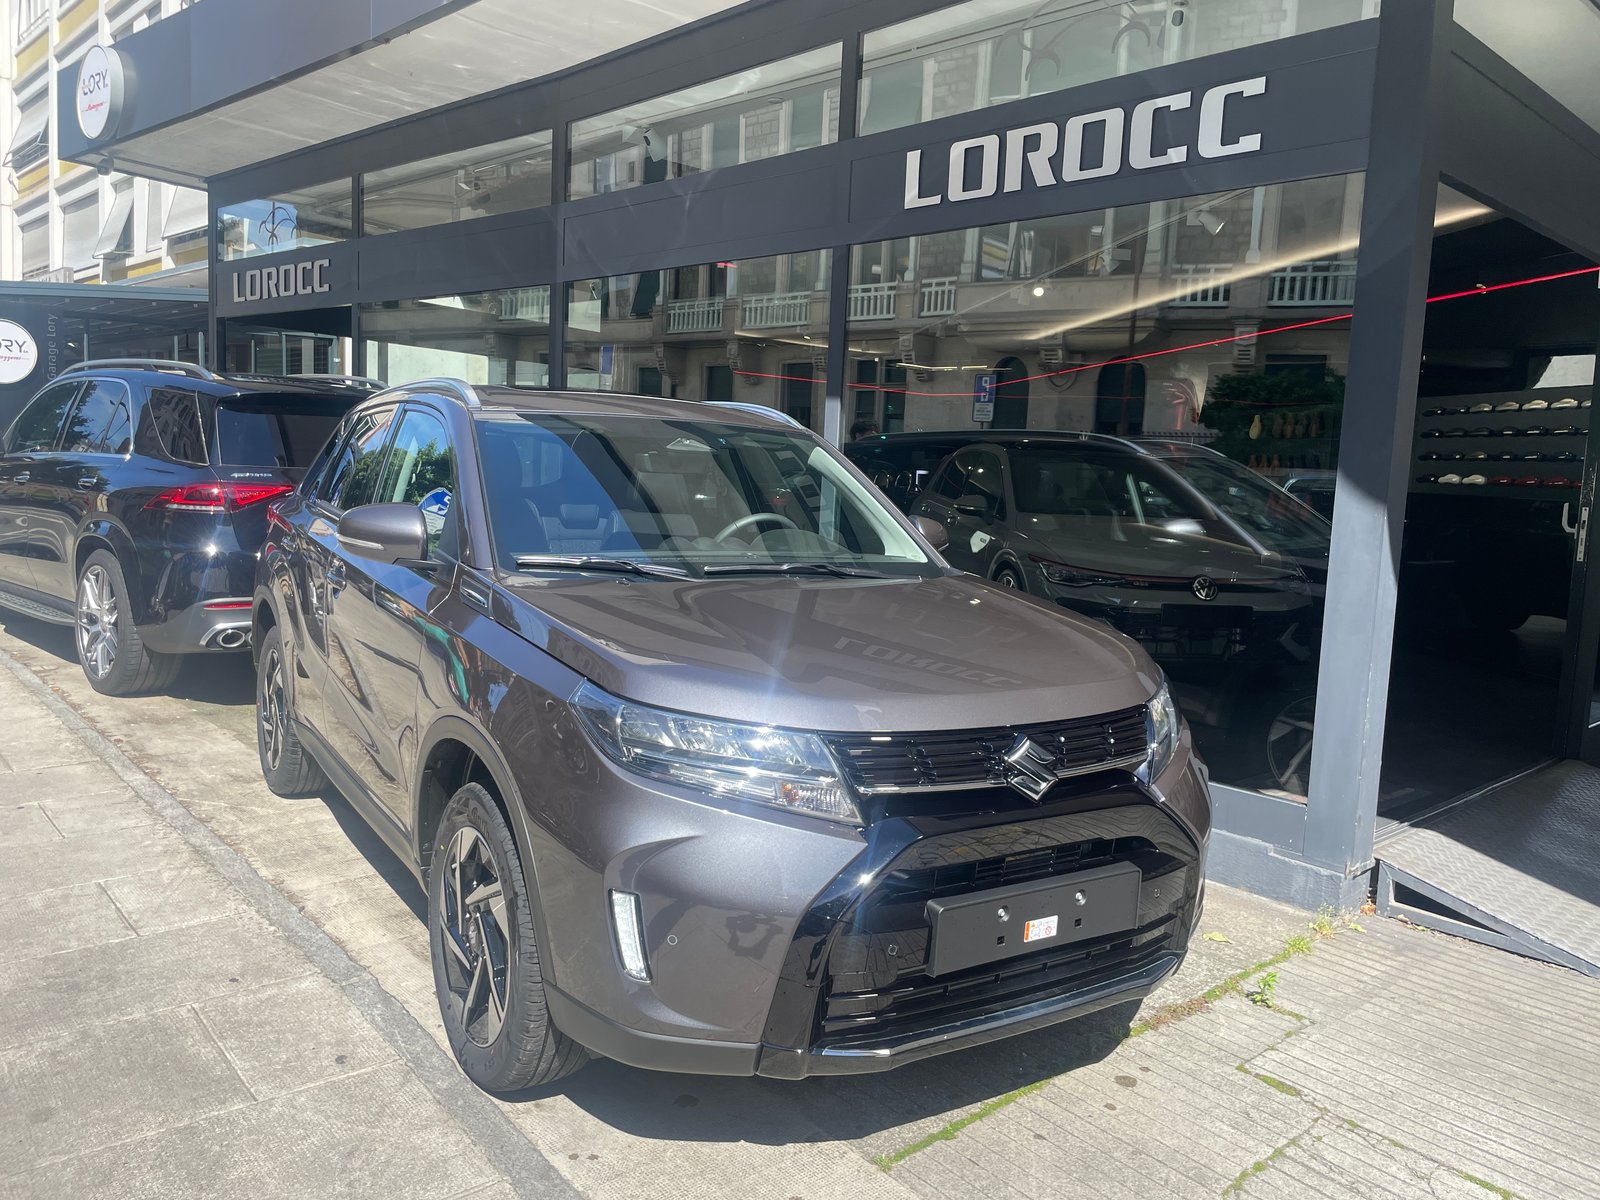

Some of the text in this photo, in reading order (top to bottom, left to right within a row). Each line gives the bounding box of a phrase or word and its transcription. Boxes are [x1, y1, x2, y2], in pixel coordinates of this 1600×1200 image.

[82, 69, 107, 96] LORY
[904, 76, 1267, 210] LOROCC
[233, 258, 330, 303] LOROCC
[0, 338, 26, 353] RY
[46, 313, 58, 381] Garage Lory
